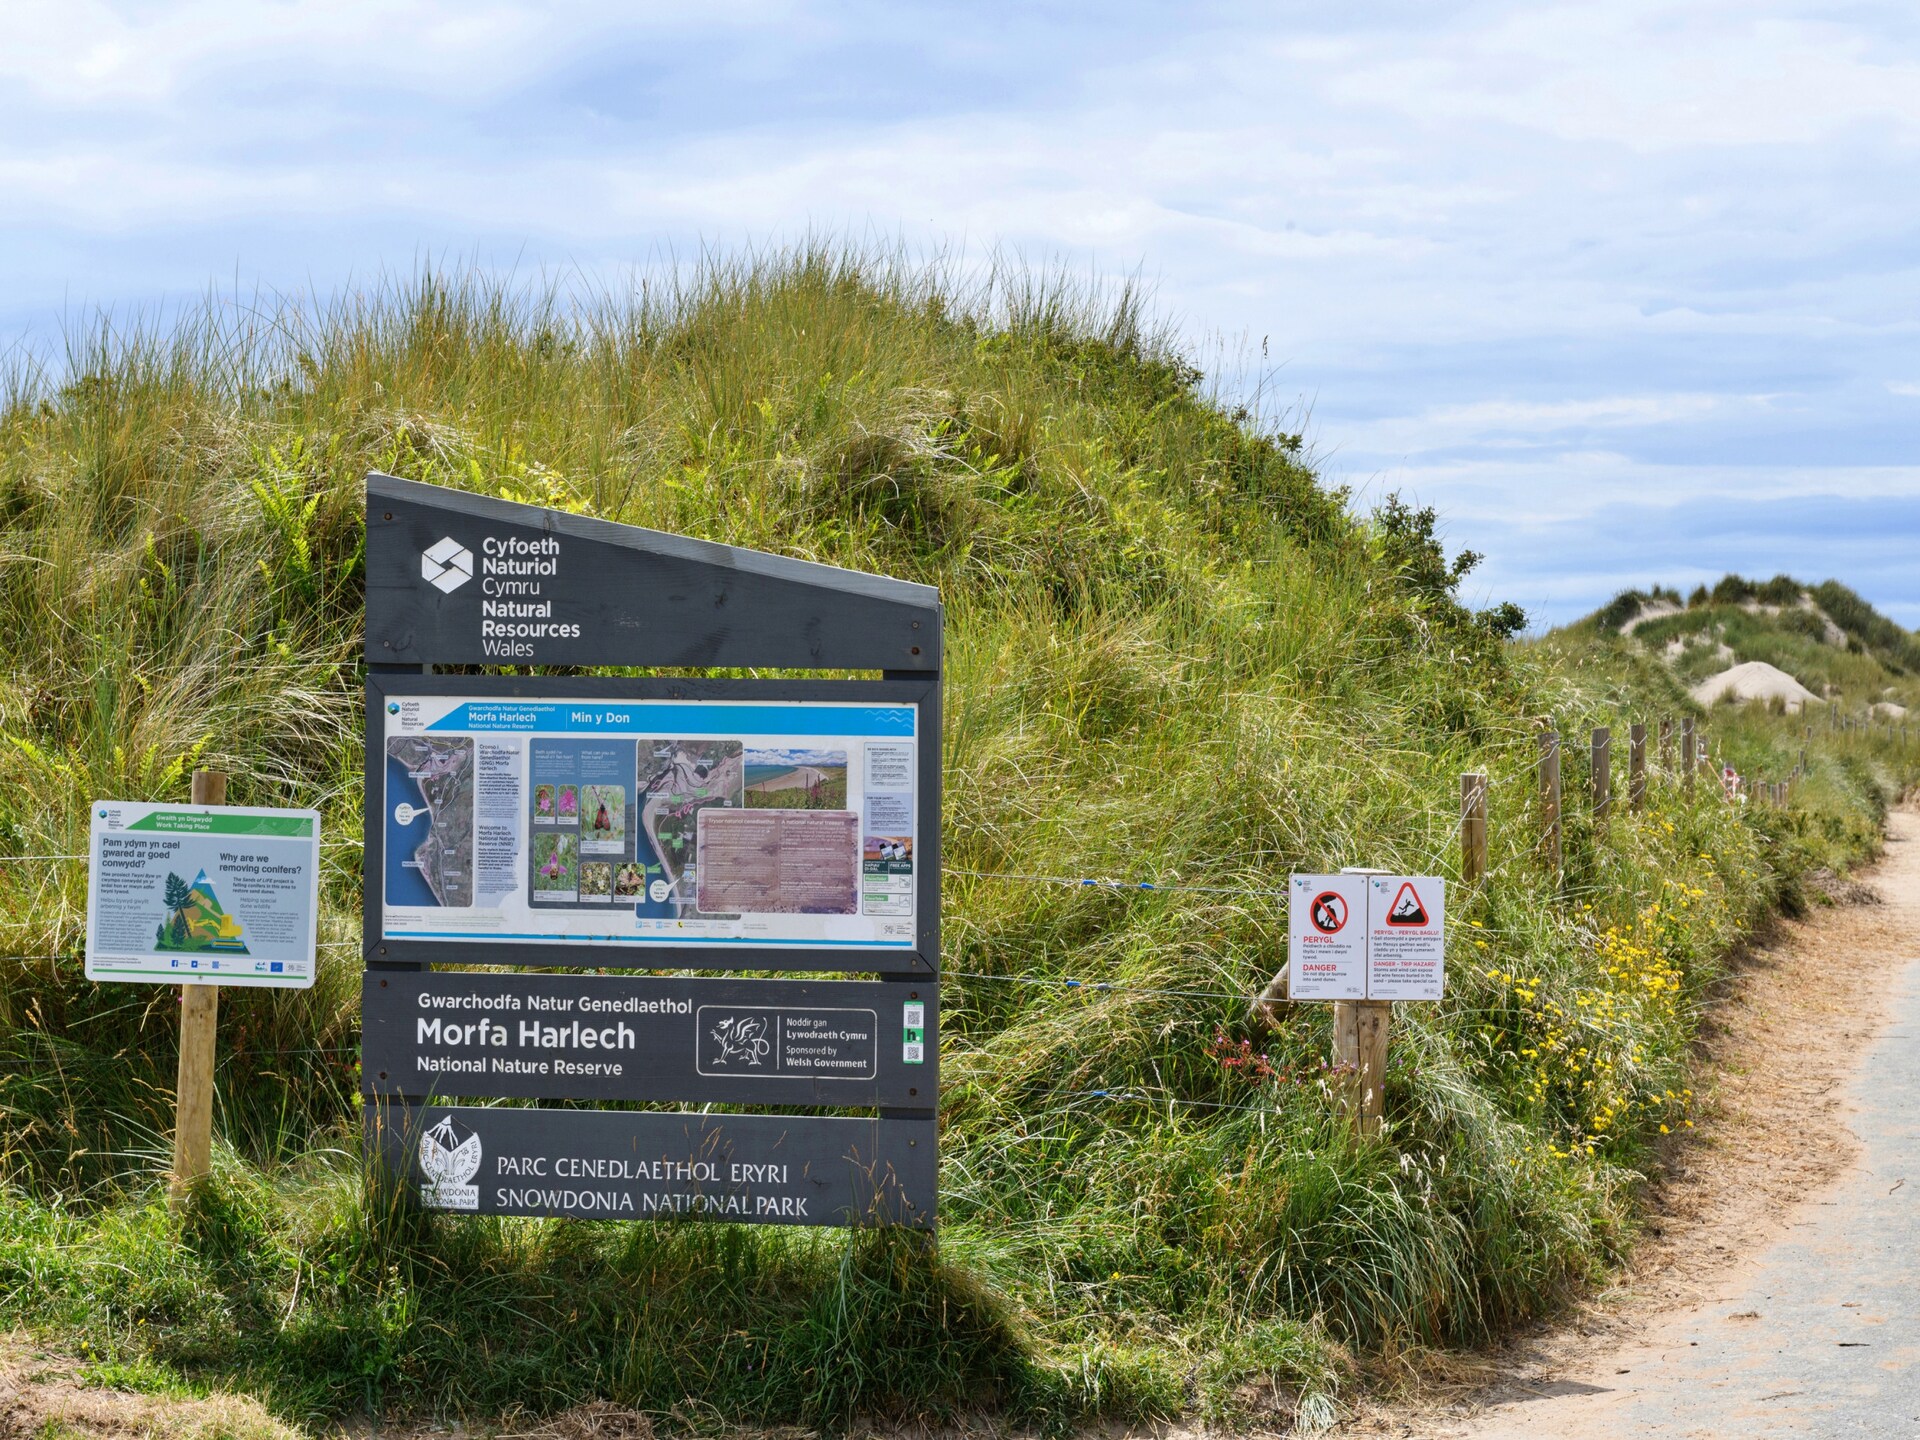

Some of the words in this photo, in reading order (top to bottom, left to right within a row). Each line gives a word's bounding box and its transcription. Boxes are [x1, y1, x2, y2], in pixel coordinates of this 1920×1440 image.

[482, 537, 560, 557] Cyfoeth
[482, 557, 557, 575] Naturiol
[482, 577, 540, 597] Cymru
[482, 600, 551, 618] Natural
[482, 620, 581, 637] Resources
[482, 639, 534, 657] Wales
[468, 712, 497, 722] Morfa
[499, 712, 537, 722] Harlech
[571, 712, 592, 723] Min
[595, 714, 603, 725] y
[606, 712, 630, 723] Don
[103, 838, 122, 846] Pam
[124, 839, 147, 849] ydym
[149, 841, 160, 849] yn
[162, 841, 180, 849] cael
[102, 849, 135, 858] gwared
[148, 851, 170, 860] goed
[219, 853, 238, 863] Why
[102, 860, 146, 869] conwydd?
[219, 864, 260, 874] removing
[261, 865, 302, 874] conifers?
[418, 992, 521, 1010] Gwarchodfa
[527, 995, 574, 1011] Natur
[578, 996, 692, 1014] Genedlaethol
[786, 1018, 812, 1027] Noddir
[813, 1019, 827, 1029] gan
[417, 1017, 508, 1047] Morfa
[519, 1020, 636, 1050] Harlech
[786, 1030, 838, 1040] Lywodraeth
[839, 1031, 868, 1041] Cymru
[786, 1046, 827, 1057] Sponsored
[828, 1046, 837, 1057] by
[417, 1056, 486, 1073] National
[492, 1058, 549, 1074] Nature
[554, 1060, 623, 1076] Reserve
[786, 1057, 812, 1067] Welsh
[814, 1058, 867, 1068] Government
[497, 1156, 547, 1176] PARC
[555, 1158, 721, 1182] CENEDLAETHOL
[731, 1164, 788, 1183] ERYRI
[496, 1188, 634, 1211] SNOWDONIA
[643, 1193, 753, 1215] NATIONAL
[756, 1196, 809, 1216] PARK
